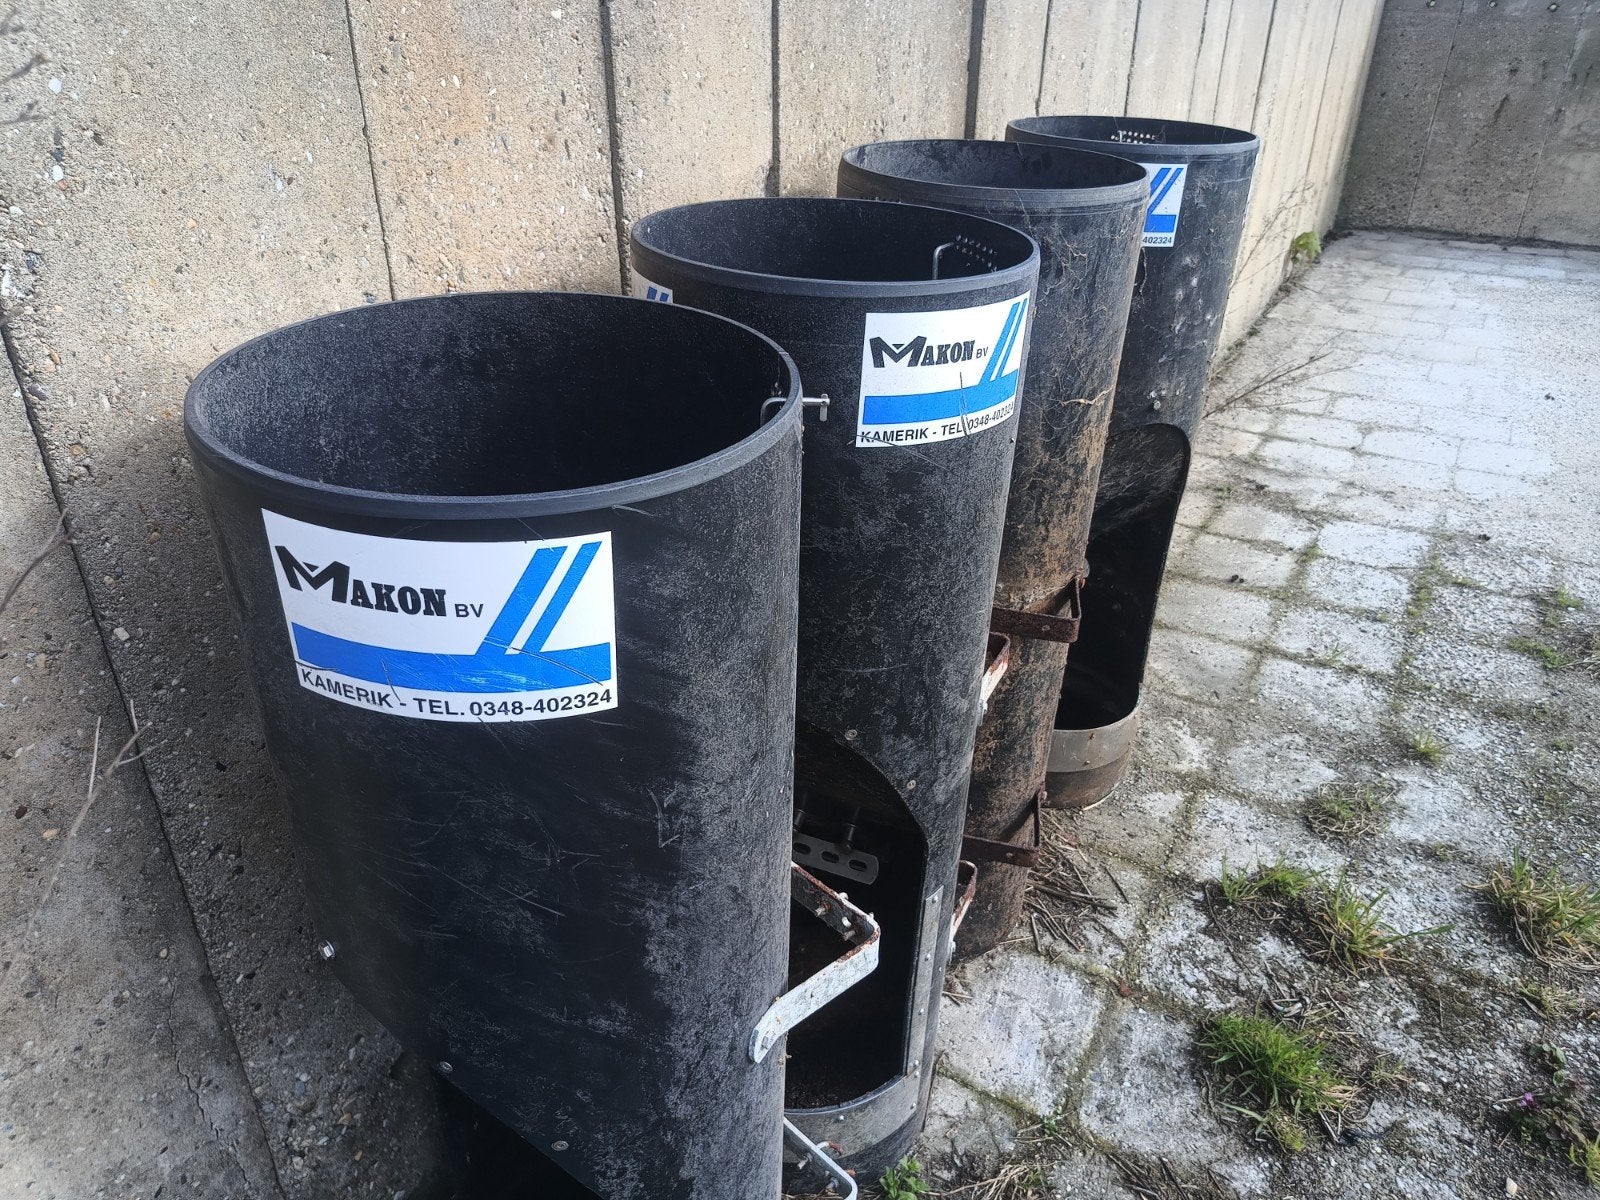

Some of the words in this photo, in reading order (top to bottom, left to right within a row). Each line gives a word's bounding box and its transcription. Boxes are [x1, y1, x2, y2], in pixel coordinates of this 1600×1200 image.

[869, 335, 975, 369] MAKON
[975, 346, 989, 359] BV
[860, 427, 929, 443] KAMERIK
[274, 545, 447, 617] MAKON
[455, 603, 484, 618] BV
[301, 668, 394, 709] KAMERIK
[412, 697, 465, 716] TEL.
[469, 688, 612, 716] 0348-402324
